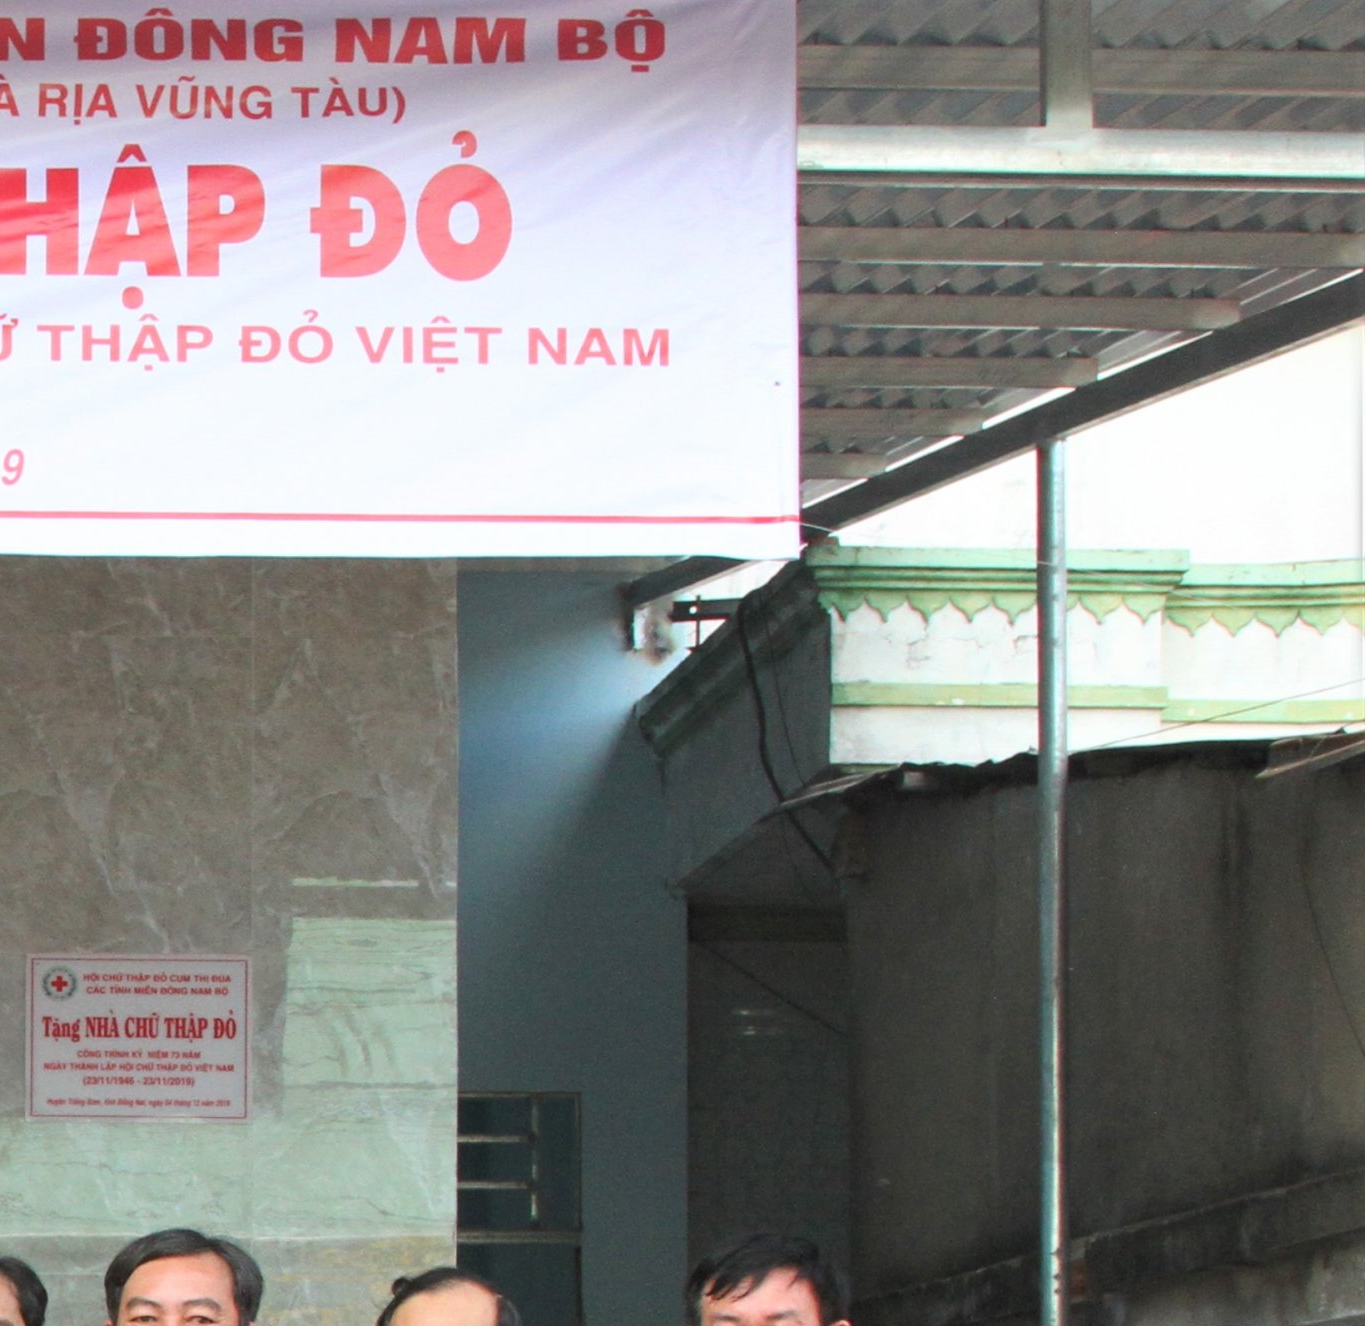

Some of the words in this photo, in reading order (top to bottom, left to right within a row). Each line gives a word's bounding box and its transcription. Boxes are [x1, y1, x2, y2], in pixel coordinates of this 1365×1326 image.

[74, 8, 305, 63] ĐÔNG
[334, 16, 527, 65] NAM
[557, 9, 666, 74] BỘ
[38, 83, 118, 126] RỊA
[136, 76, 273, 120] VŨNG
[290, 77, 406, 124] TÀU)
[310, 130, 512, 282] ĐỎ
[37, 314, 213, 371] THẬP
[239, 309, 333, 364] ĐỎ
[356, 316, 502, 373] VIỆT
[528, 328, 669, 366] NAM
[42, 1016, 81, 1042] Tặng
[85, 1009, 119, 1038] NHÀ
[124, 1012, 160, 1038] CHỮ
[164, 1012, 208, 1043] THẬP
[213, 1009, 237, 1039] ĐỎ
